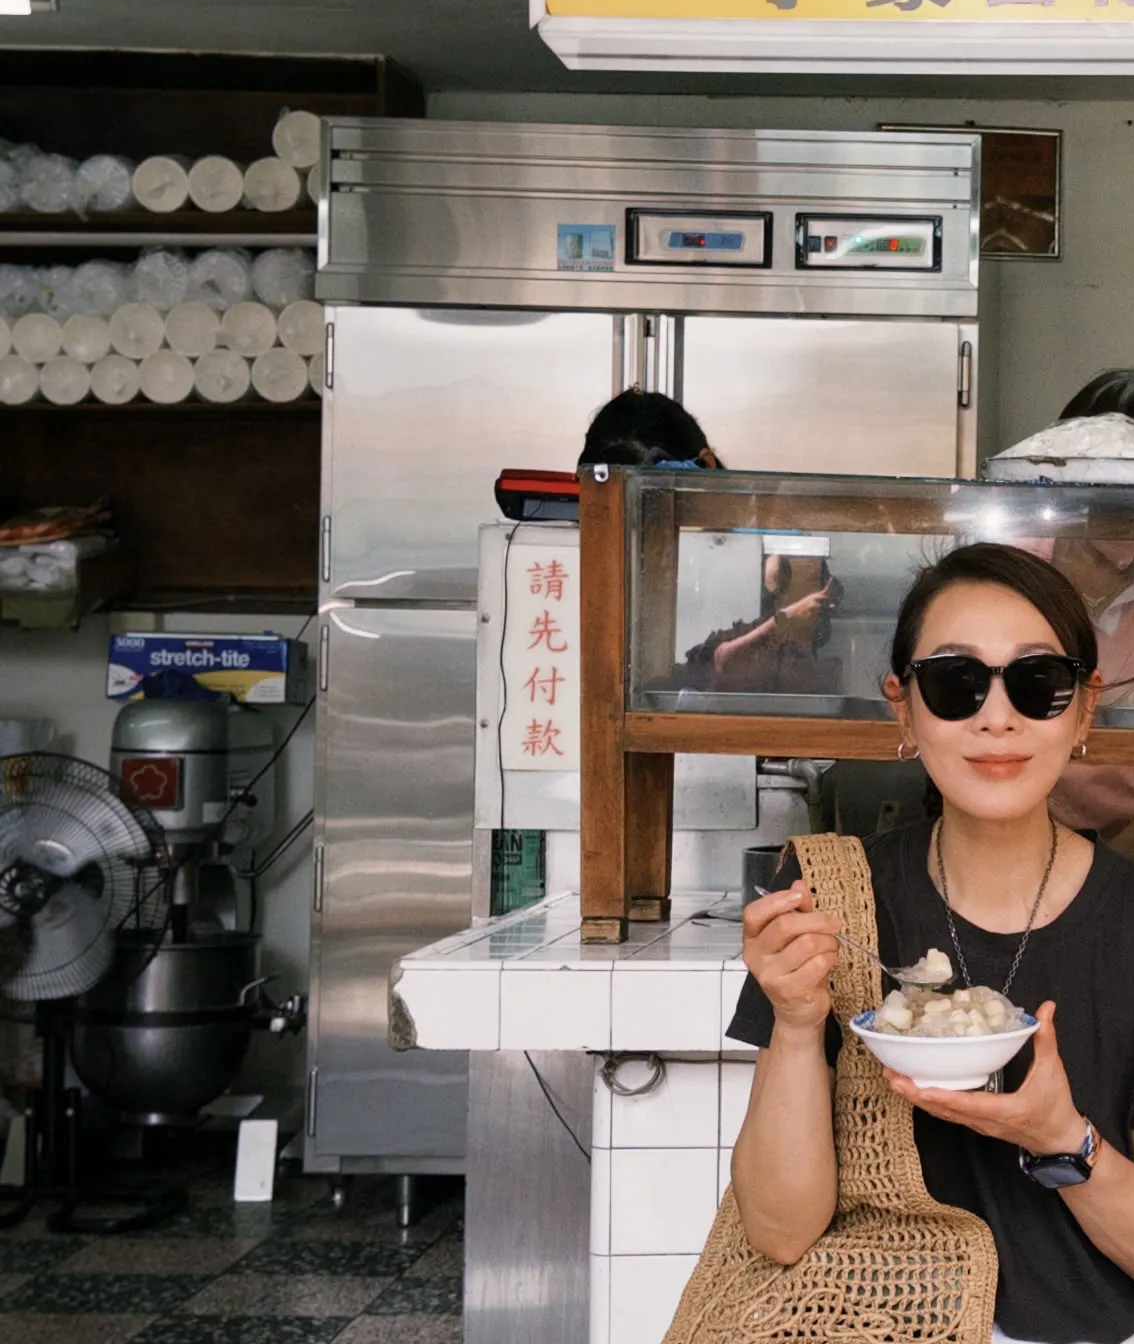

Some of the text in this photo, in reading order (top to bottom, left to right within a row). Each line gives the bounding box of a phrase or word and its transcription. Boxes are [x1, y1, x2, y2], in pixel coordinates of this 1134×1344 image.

[150, 649, 250, 668] stretch-tite
[521, 560, 570, 757] 請先付款
